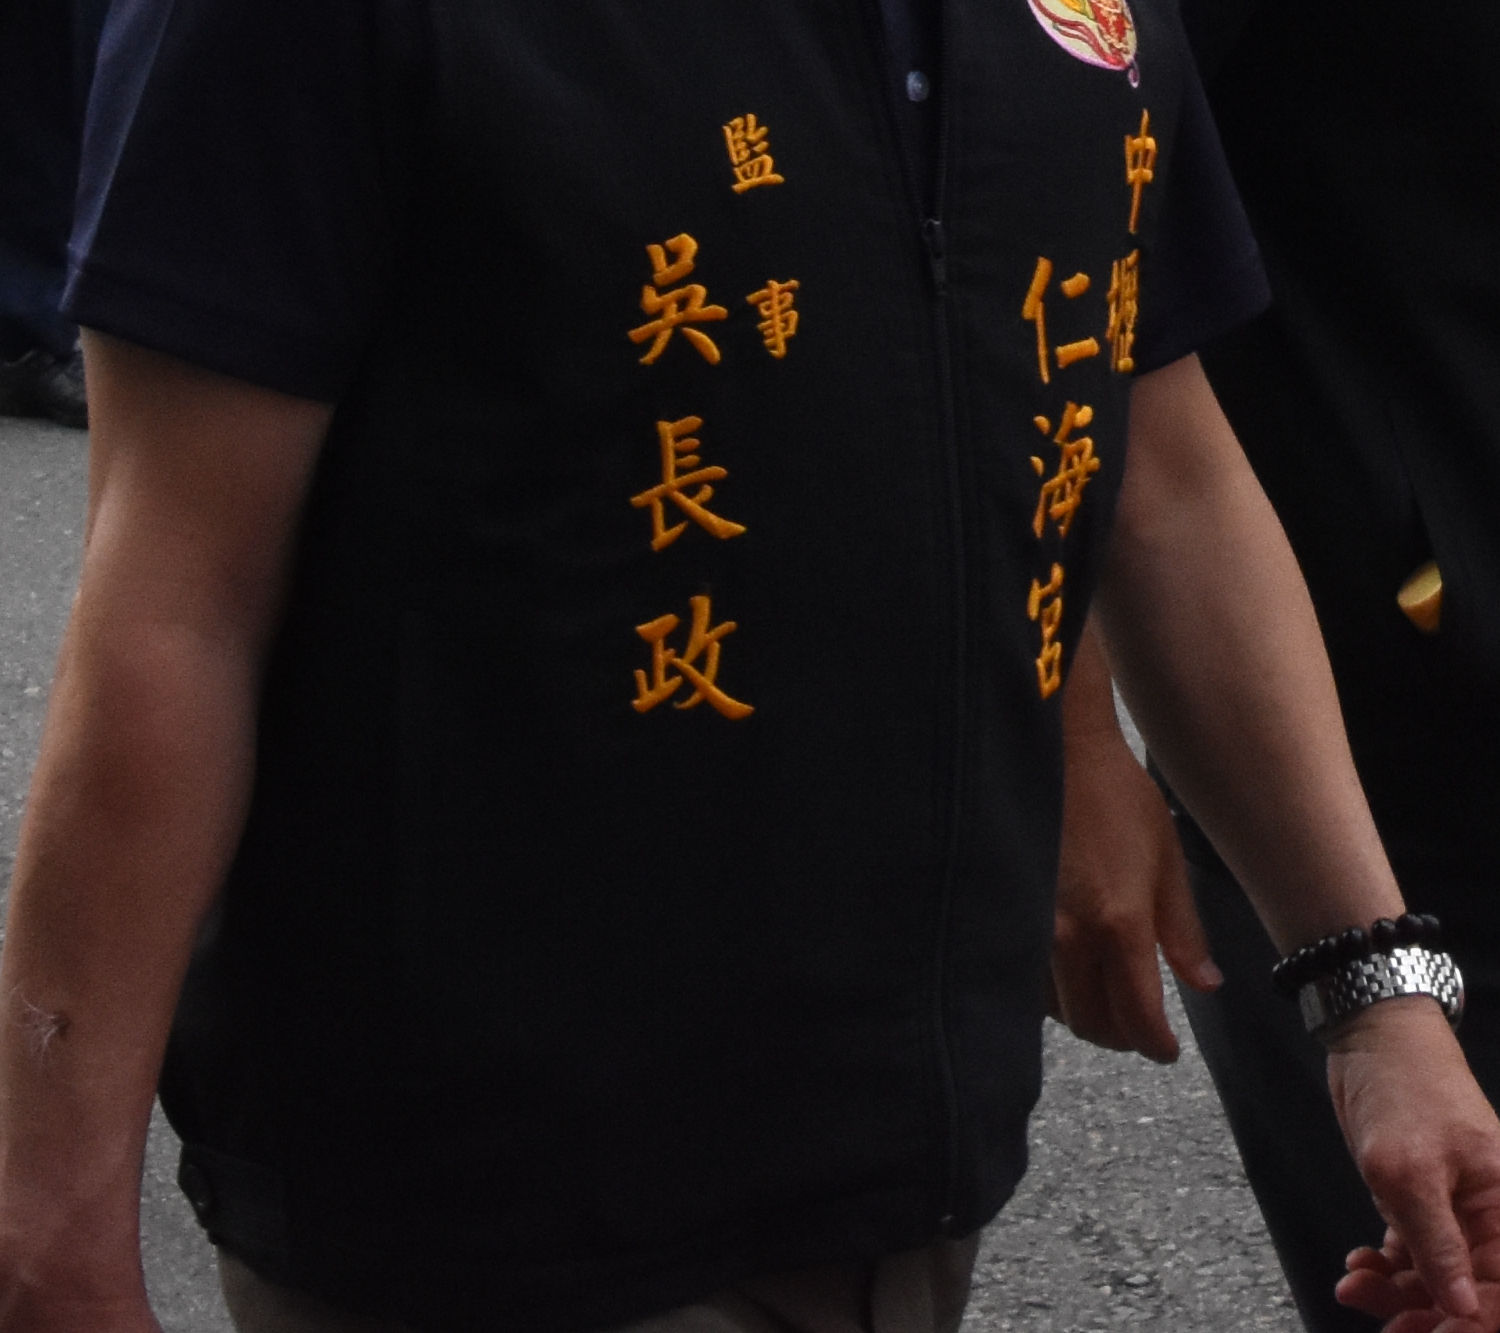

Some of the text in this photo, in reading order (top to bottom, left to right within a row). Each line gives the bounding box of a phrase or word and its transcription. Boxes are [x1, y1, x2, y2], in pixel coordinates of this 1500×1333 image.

[722, 113, 801, 359] 監事
[628, 232, 755, 720] 吳長政
[1023, 256, 1100, 700] 仁海宮
